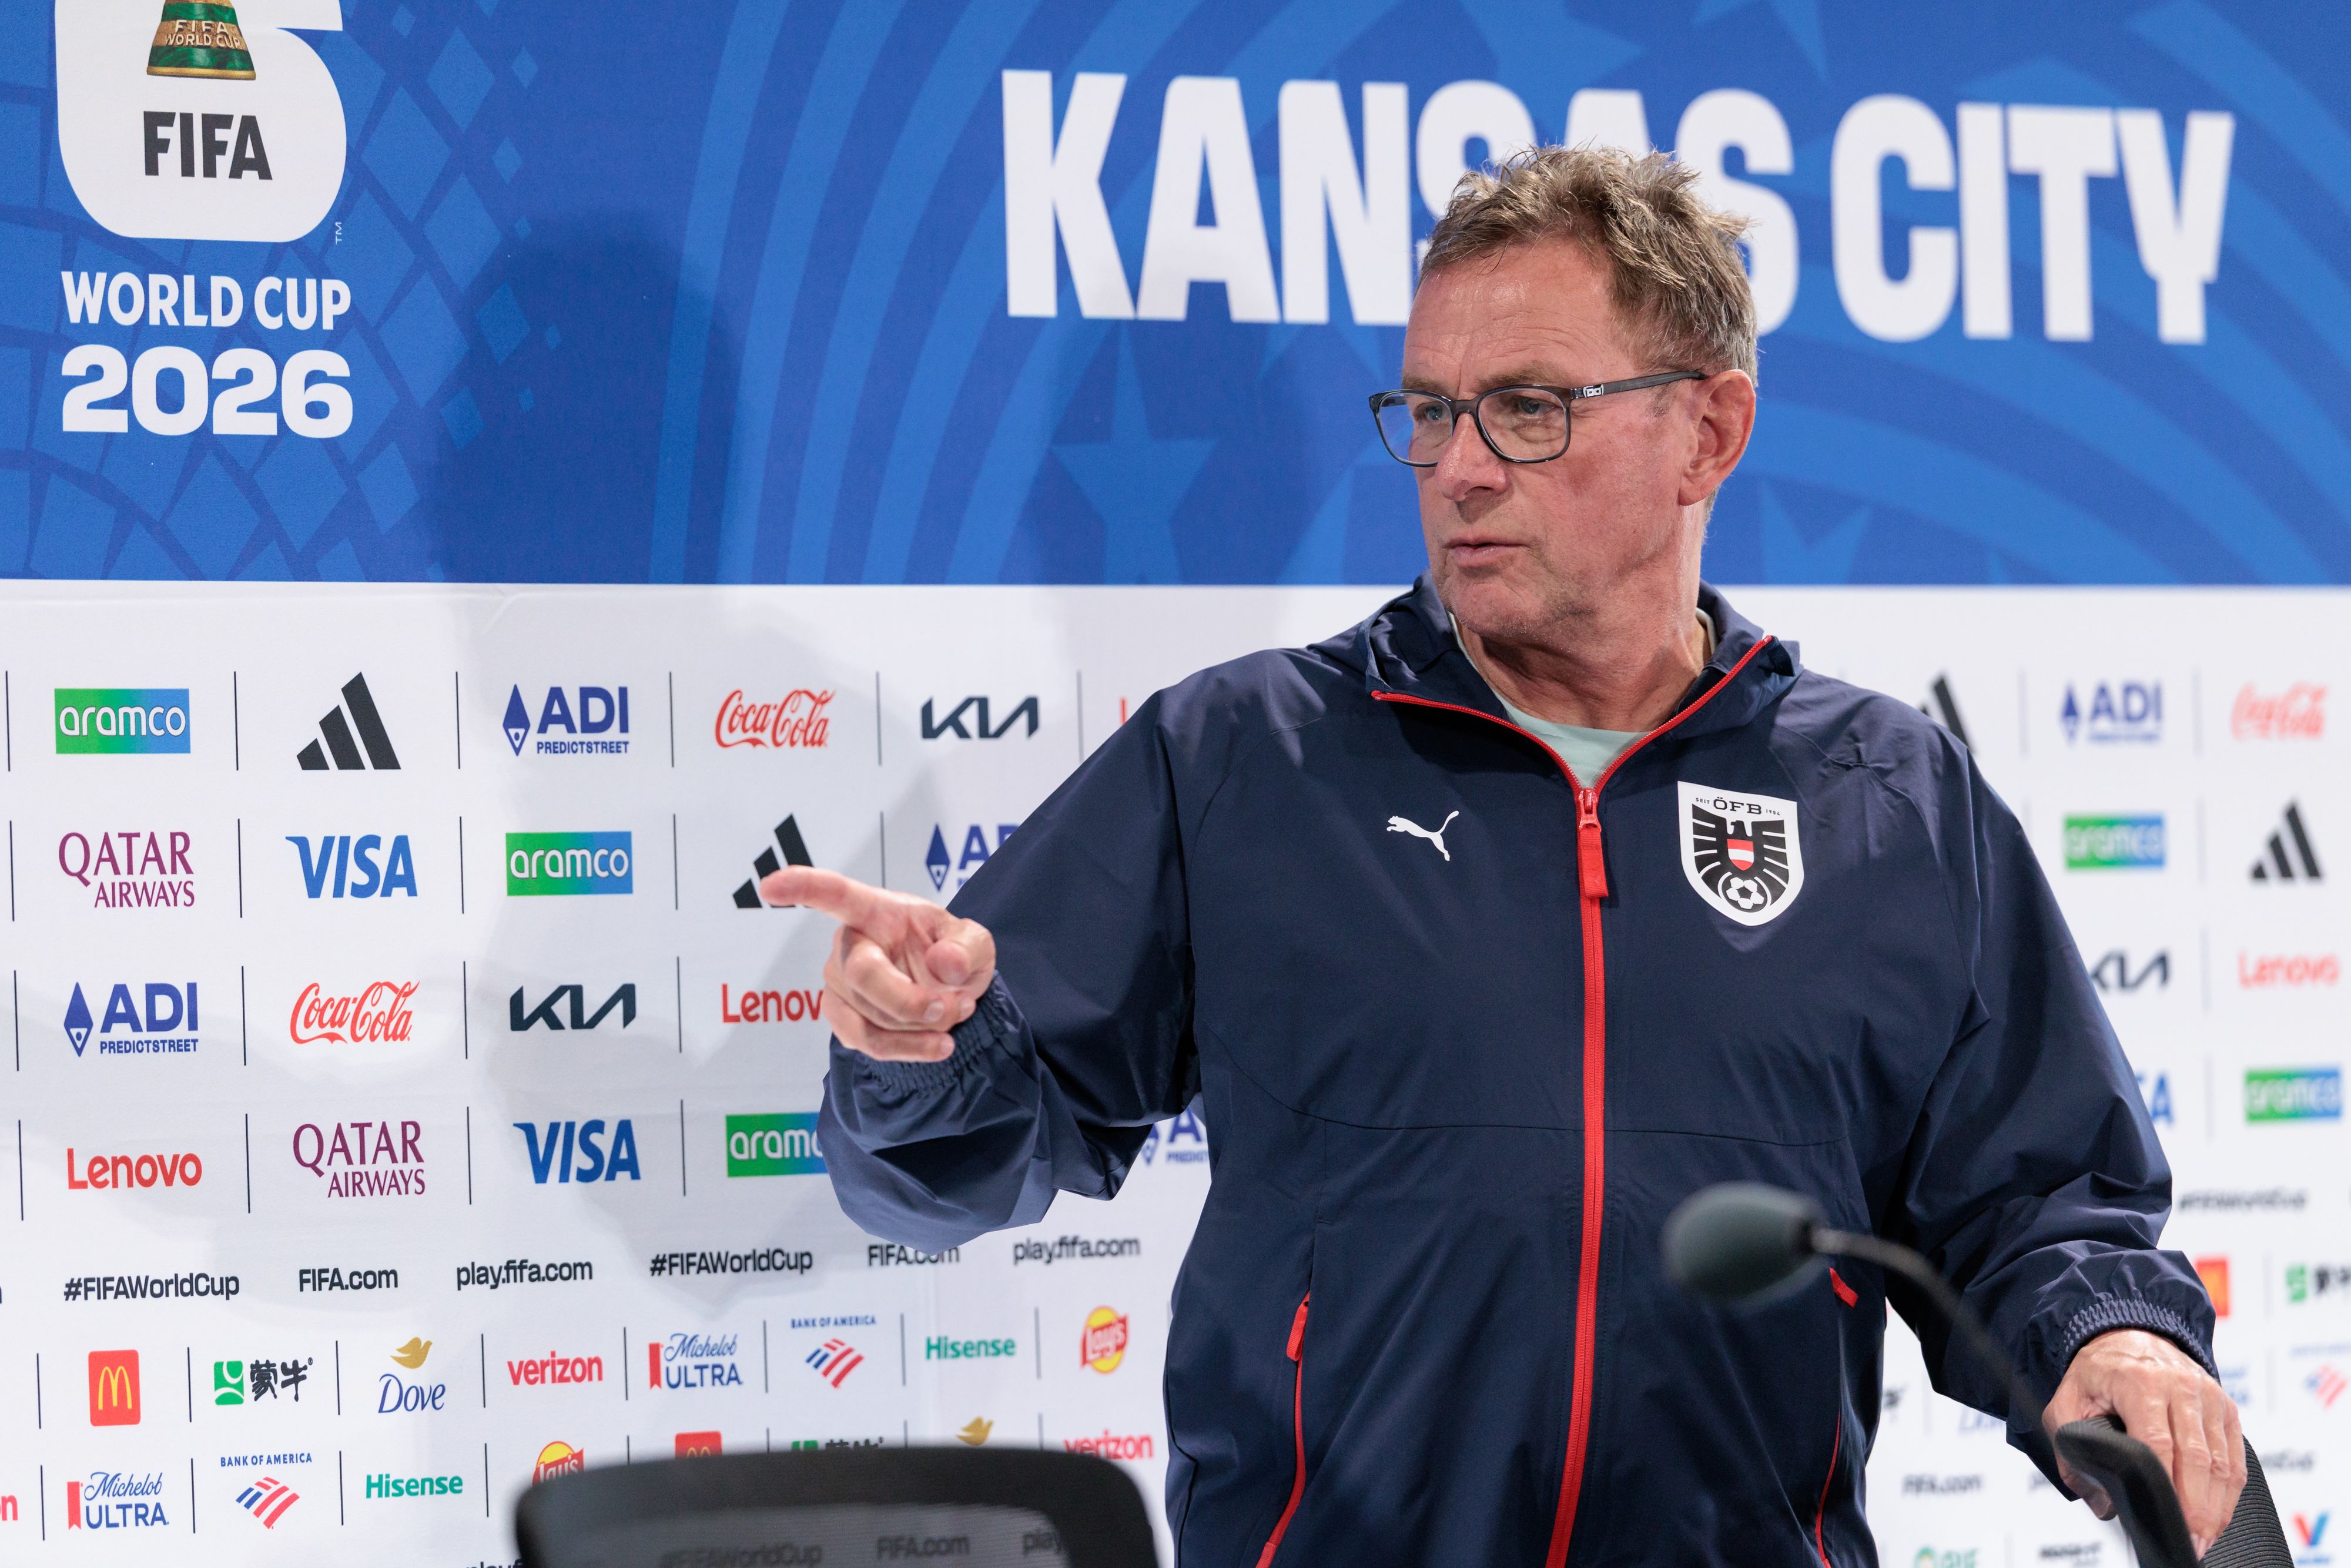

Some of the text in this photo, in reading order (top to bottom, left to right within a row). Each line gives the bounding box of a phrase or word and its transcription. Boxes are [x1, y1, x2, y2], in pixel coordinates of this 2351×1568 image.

[165, 33, 241, 48] WORLD CUP
[175, 19, 230, 34] FIFA
[143, 110, 273, 180] FIFA
[1832, 94, 2235, 345] CITY
[61, 271, 351, 330] WORLD CUP
[61, 344, 353, 438] 2026
[537, 686, 629, 735] ADI
[2089, 681, 2163, 723] ADI
[59, 706, 186, 737] aramco
[537, 741, 629, 755] PREDICTSTREET
[1713, 797, 1762, 815] ÖFB
[59, 832, 194, 887] QATAR
[285, 835, 418, 899] VISA
[510, 848, 629, 879] aramco
[94, 880, 195, 909] AIRWAYS
[100, 982, 199, 1033] ADI
[722, 983, 823, 1023] Lenov
[100, 1039, 199, 1054] PREDICTSTREET
[293, 1121, 425, 1178] QATAR
[513, 1119, 641, 1184] VISA
[66, 1148, 203, 1190] Lenovo
[327, 1168, 426, 1198] AIRWAYS
[649, 1248, 813, 1277] #FIFAWorldCup
[1013, 1235, 1141, 1264] play.fifa.com
[64, 1273, 240, 1301] #FIFAWorldCup
[299, 1268, 398, 1292] FIFA.com
[456, 1259, 593, 1291] play.fifa.com
[791, 1314, 877, 1329] BANK OF AMERICA
[664, 1333, 738, 1362] Michelob
[926, 1336, 1017, 1361] Hisense
[507, 1350, 603, 1386] verizon
[666, 1362, 742, 1389] ULTRA
[378, 1374, 446, 1413] Dove
[220, 1452, 312, 1467] BANK OF AMERICA
[84, 1472, 163, 1501] Michelob
[366, 1473, 463, 1499] Hisense
[85, 1502, 168, 1529] ULTRA
